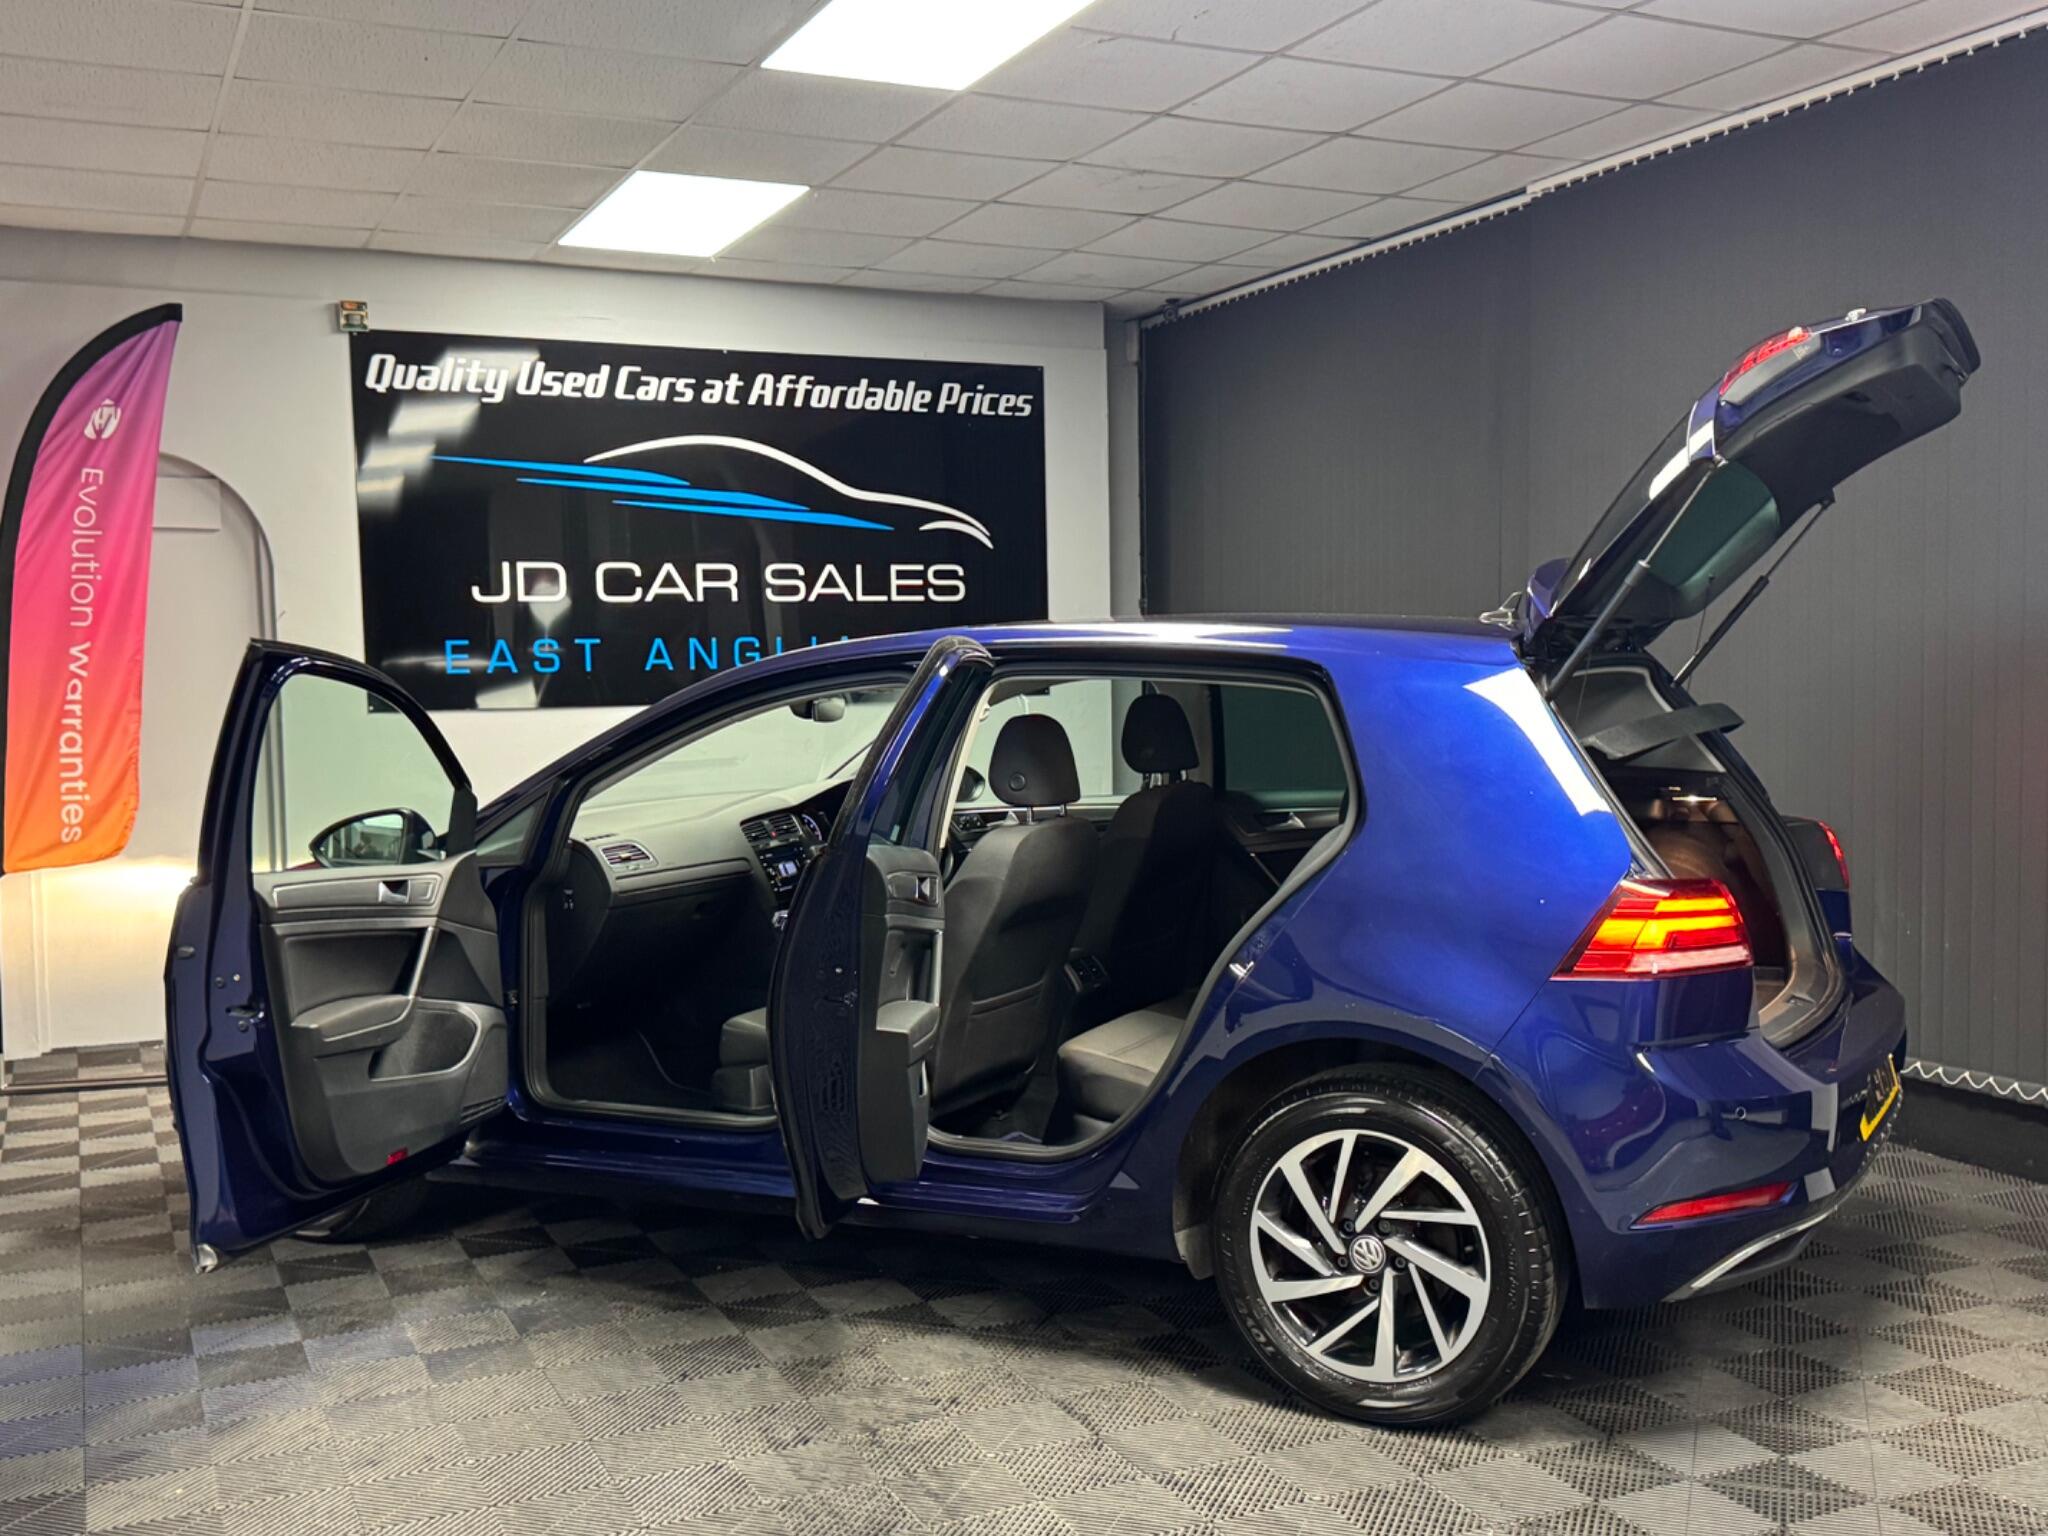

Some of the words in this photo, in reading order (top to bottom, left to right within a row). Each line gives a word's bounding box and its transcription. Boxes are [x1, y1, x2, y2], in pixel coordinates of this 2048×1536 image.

[365, 353, 510, 403] Quality
[516, 361, 611, 399] Used
[614, 365, 697, 403] Cars
[700, 373, 745, 405] at
[747, 373, 932, 413] Affordable
[936, 382, 1035, 417] Prices
[69, 467, 104, 628] Evolution
[471, 561, 568, 603] JD
[596, 562, 739, 603] CAR
[764, 563, 967, 603] SALES
[445, 637, 602, 675] EAST
[644, 635, 849, 672] ANG
[58, 640, 92, 844] warranties
